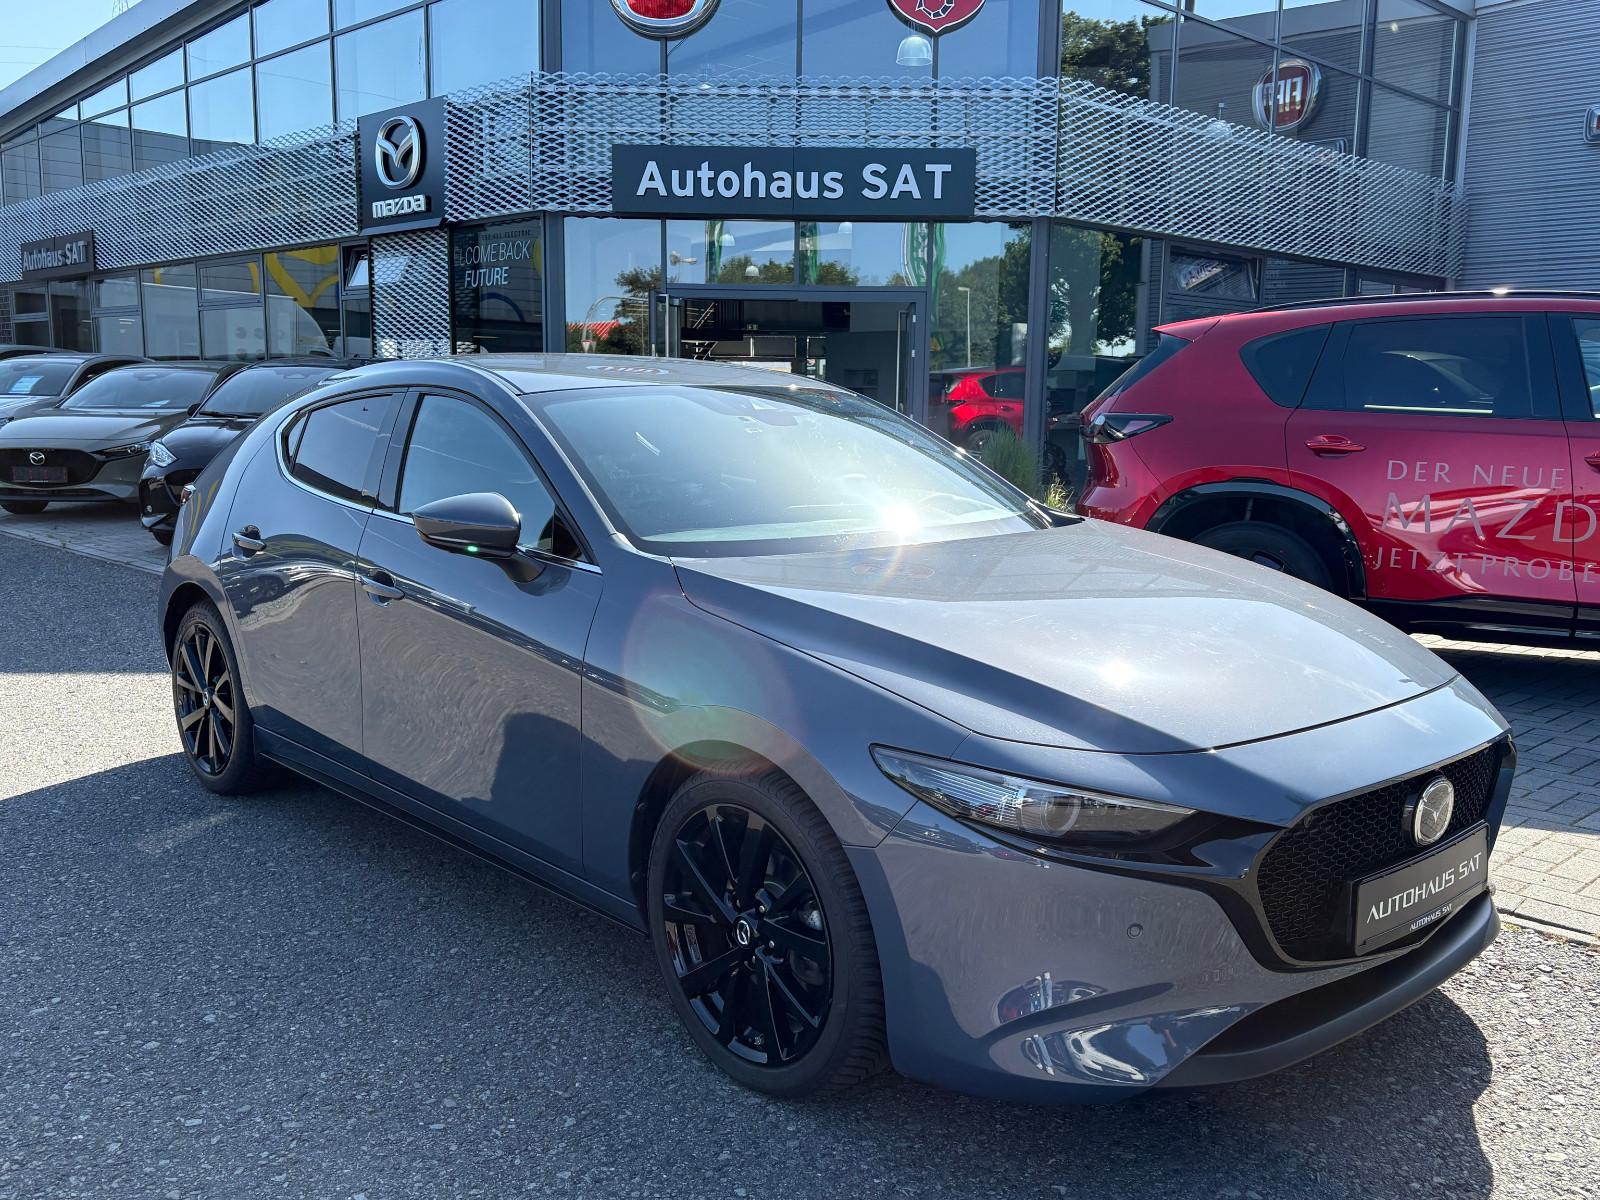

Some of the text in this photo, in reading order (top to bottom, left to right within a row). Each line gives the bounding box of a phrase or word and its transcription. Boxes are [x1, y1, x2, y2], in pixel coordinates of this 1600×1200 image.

[636, 160, 952, 200] Autohaus SAT
[23, 240, 87, 271] Autohaus SAT
[499, 240, 530, 261] BACK
[464, 266, 509, 289] FUTURE
[1387, 460, 1566, 489] DER NEUE
[1382, 491, 1598, 544] MAZD
[1372, 547, 1598, 584] JETZT PROBE
[1366, 852, 1482, 924] AUTOHAUS SAT
[1409, 903, 1453, 931] AUTOHAUS SAT
